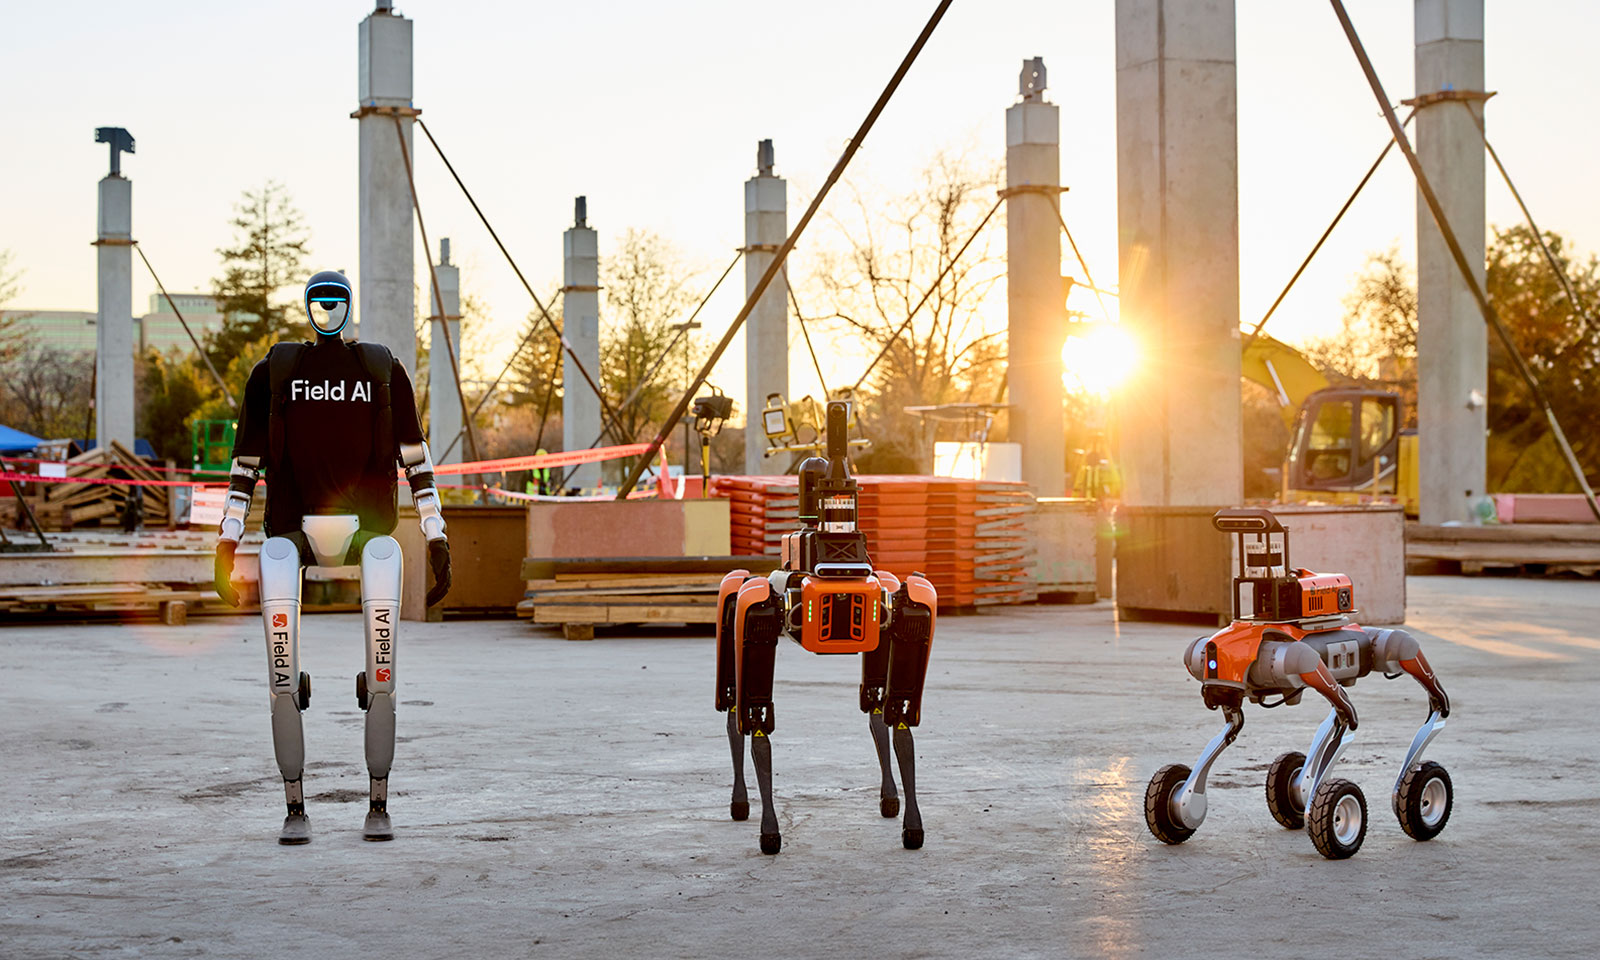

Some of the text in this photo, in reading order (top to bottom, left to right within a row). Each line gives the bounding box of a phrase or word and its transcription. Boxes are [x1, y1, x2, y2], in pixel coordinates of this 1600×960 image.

[291, 380, 371, 402] Field AI
[273, 632, 290, 687] Field AI
[375, 608, 391, 664] Field AI
